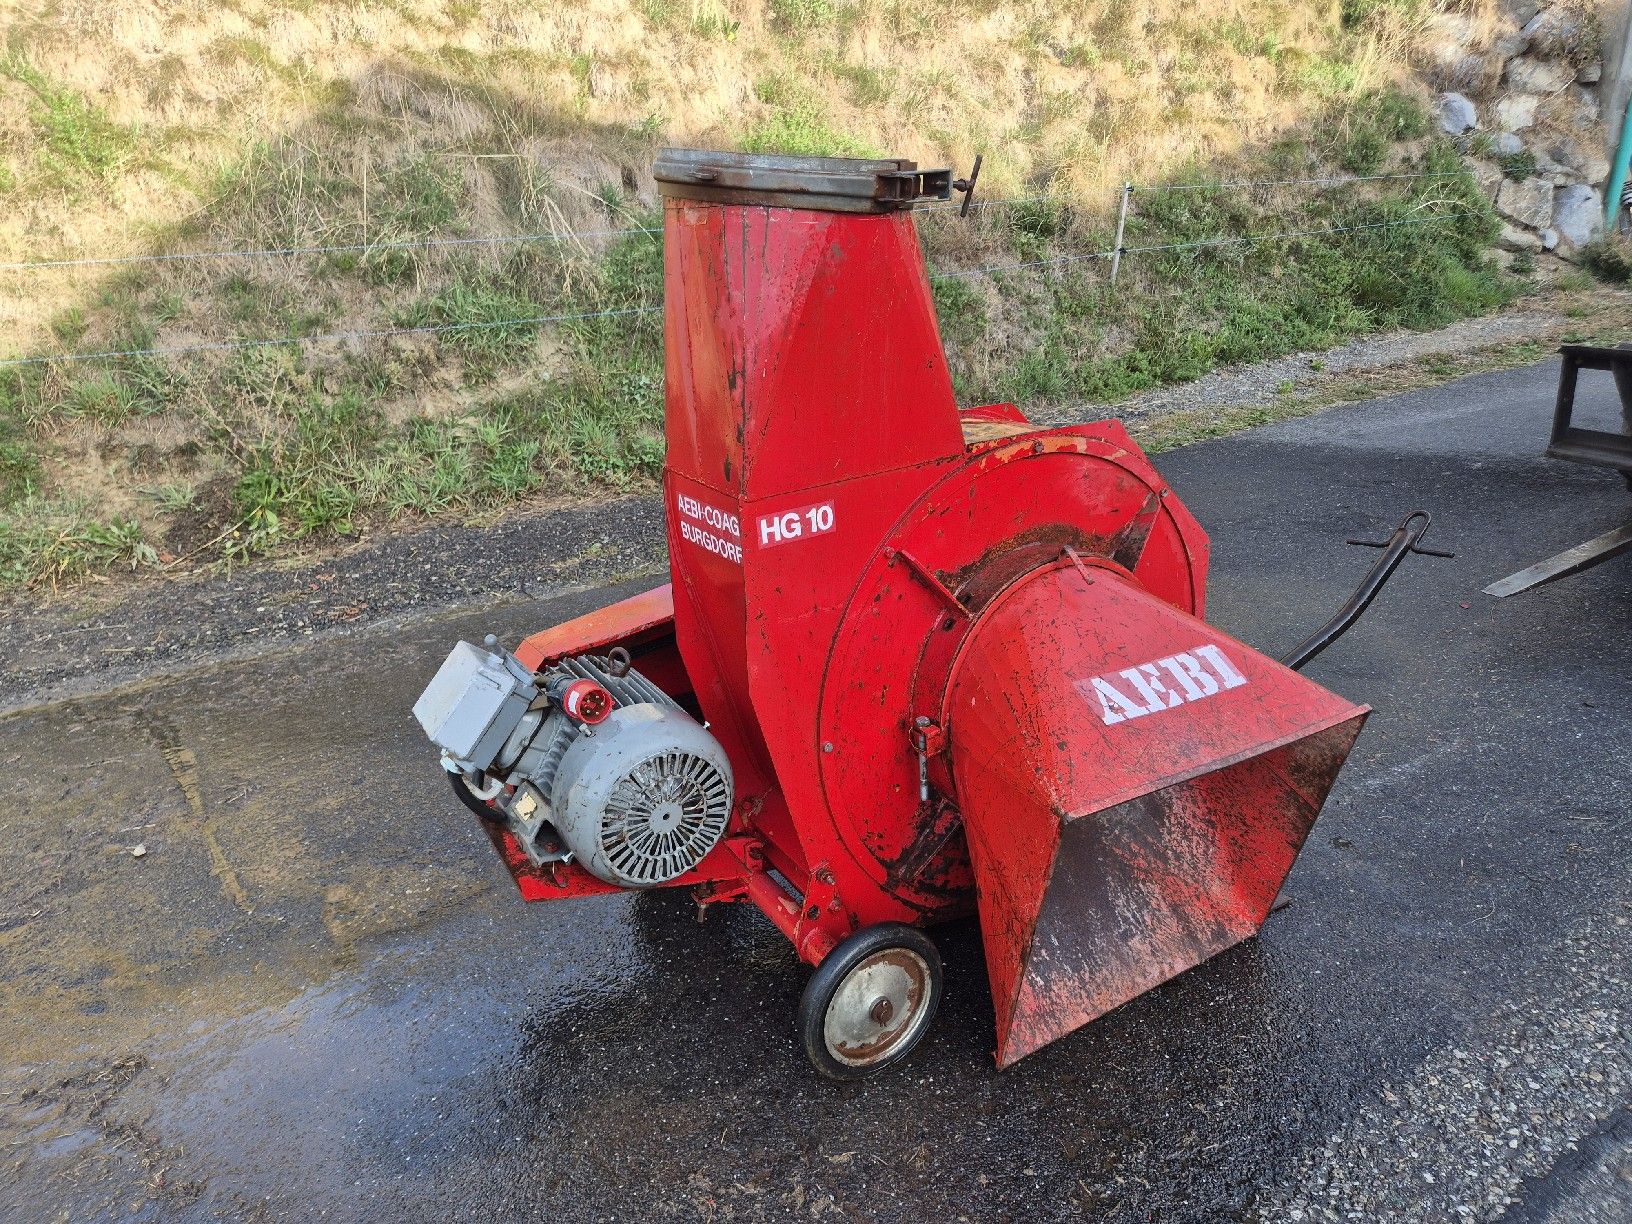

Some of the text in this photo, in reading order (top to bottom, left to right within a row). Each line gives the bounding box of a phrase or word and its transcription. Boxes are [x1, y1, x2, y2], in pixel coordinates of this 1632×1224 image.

[681, 521, 743, 564] BURGDORF
[761, 505, 834, 544] HG 10
[1091, 644, 1247, 725] AEBI
